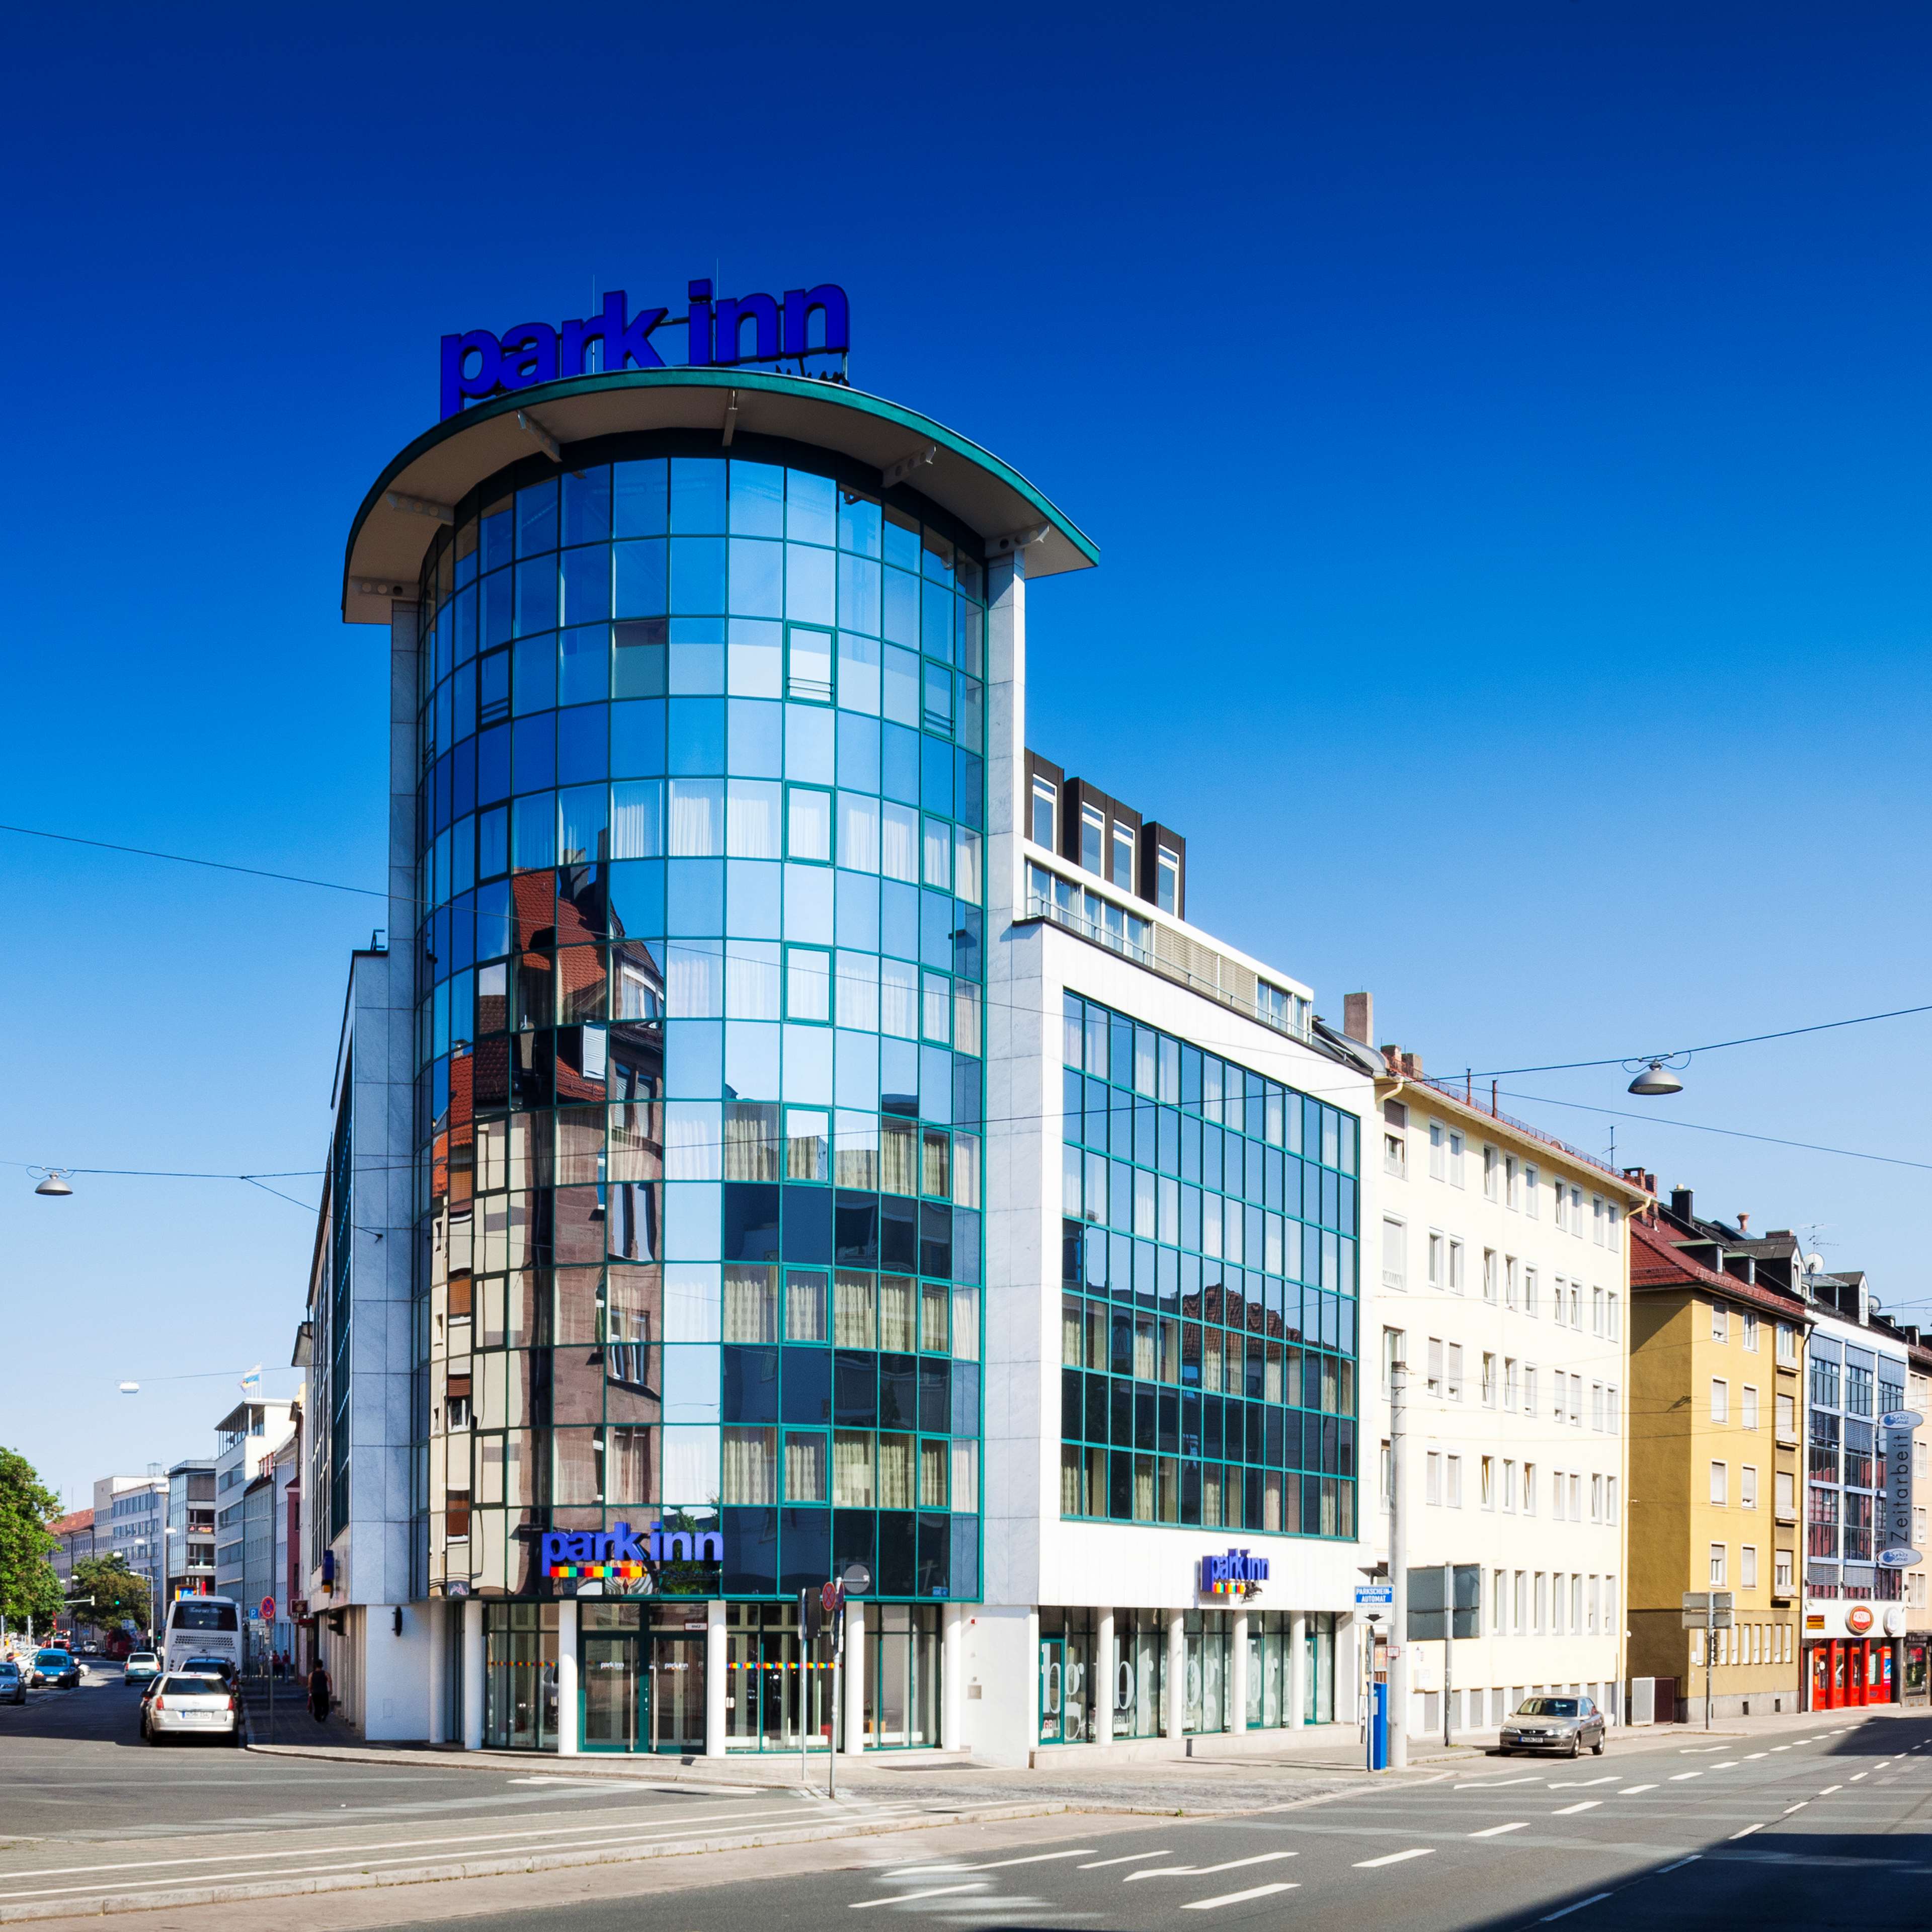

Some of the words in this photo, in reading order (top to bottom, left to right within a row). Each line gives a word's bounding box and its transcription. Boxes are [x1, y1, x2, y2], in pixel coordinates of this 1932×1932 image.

[440, 290, 669, 423] park
[688, 278, 850, 367] inn
[1890, 1435, 1908, 1543] Zeitarbeit
[541, 1521, 647, 1576] park
[650, 1521, 724, 1561] inn
[1203, 1548, 1245, 1593] park
[1241, 1549, 1269, 1580] inn
[600, 1661, 614, 1669] park
[664, 1661, 678, 1669] park
